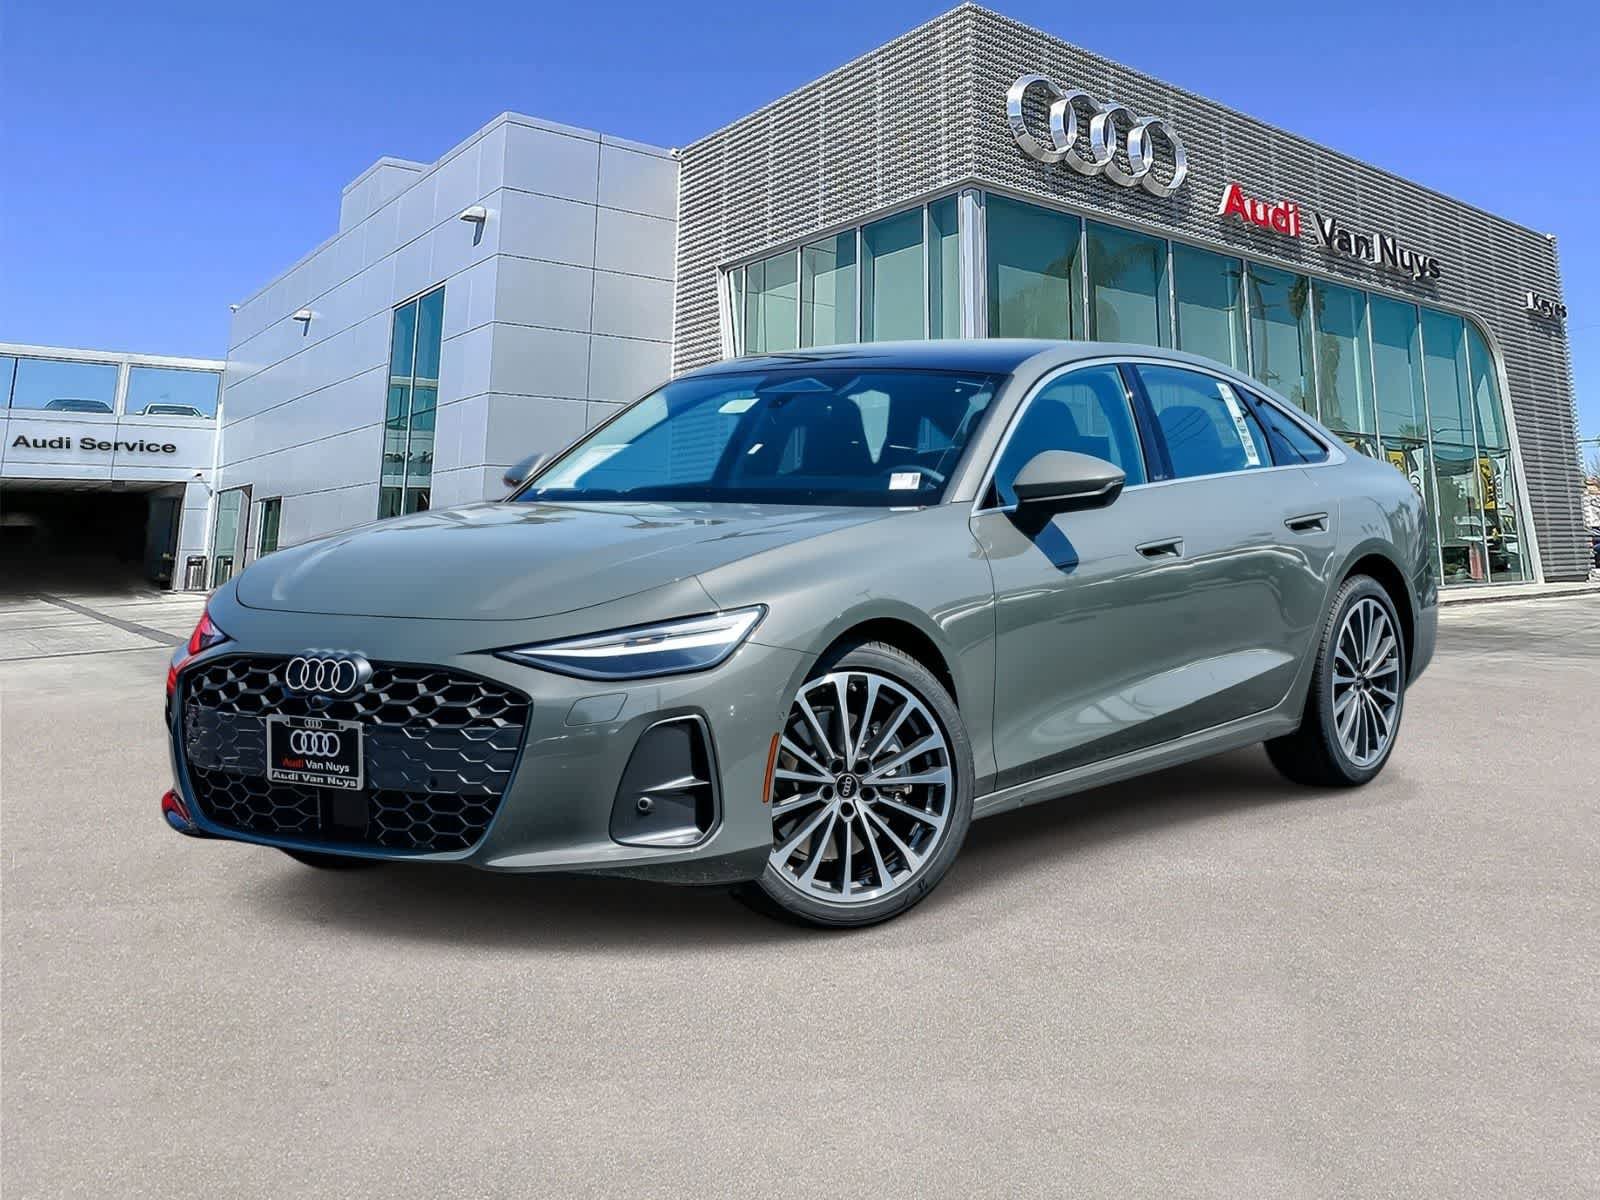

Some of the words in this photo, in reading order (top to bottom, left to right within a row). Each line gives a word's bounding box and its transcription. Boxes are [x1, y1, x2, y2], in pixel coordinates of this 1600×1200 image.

[1217, 182, 1301, 238] Audi
[1309, 213, 1371, 259] Van
[1373, 233, 1441, 280] Nuys
[12, 435, 71, 449] Audi
[79, 437, 177, 454] Service
[281, 758, 304, 769] Audi
[305, 760, 324, 770] Van
[325, 761, 350, 774] Nuys
[272, 771, 299, 781] Audi
[302, 774, 324, 783] Van
[327, 777, 356, 788] Nuys
